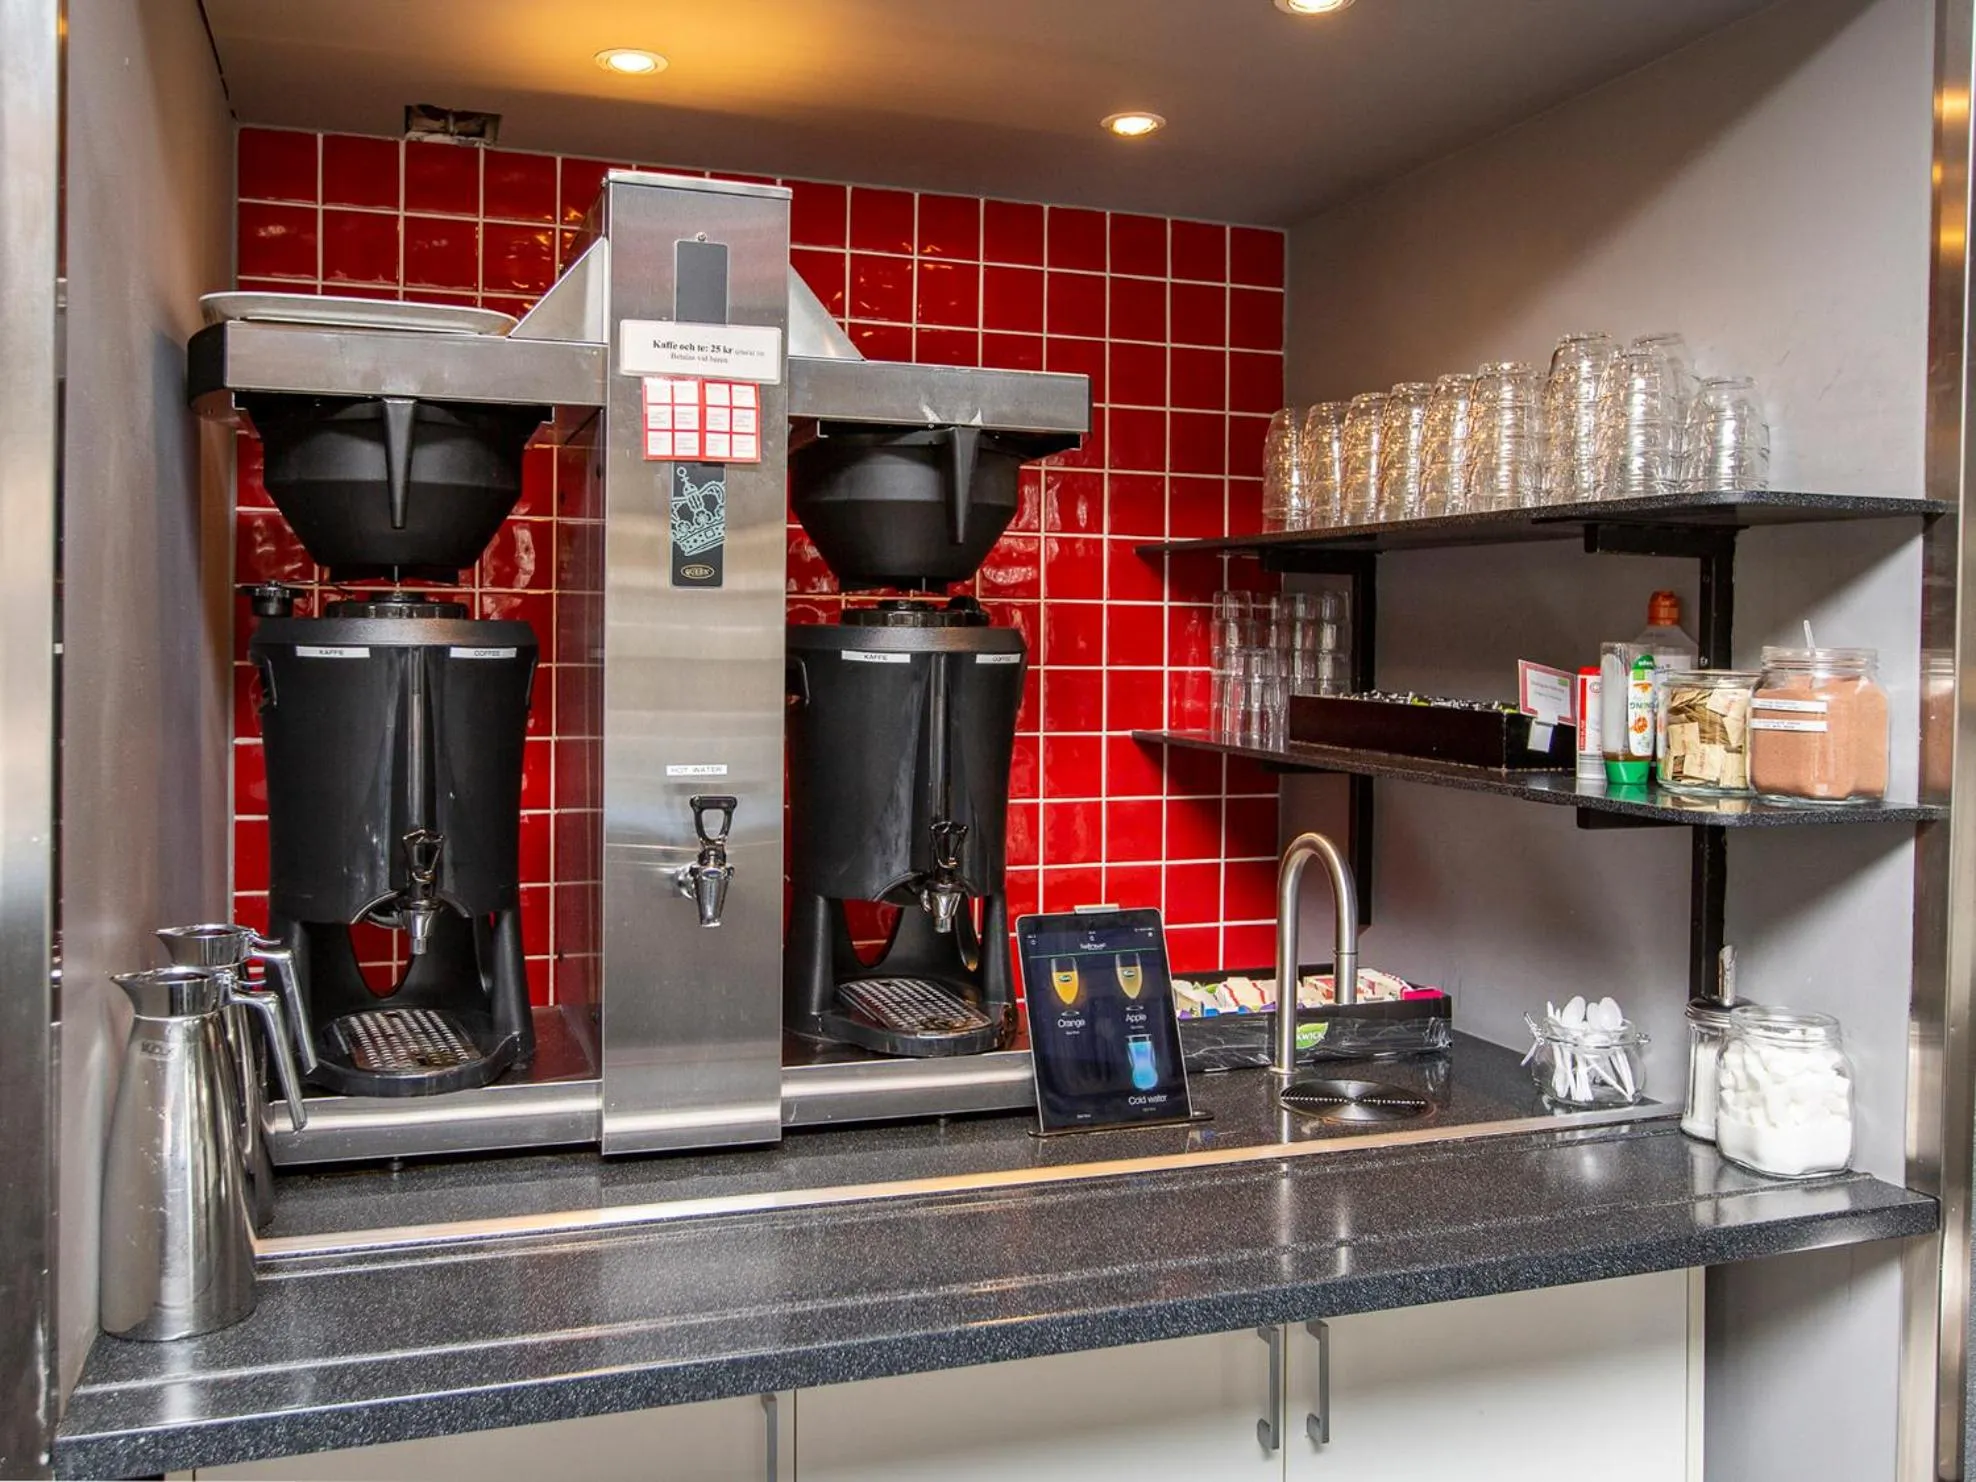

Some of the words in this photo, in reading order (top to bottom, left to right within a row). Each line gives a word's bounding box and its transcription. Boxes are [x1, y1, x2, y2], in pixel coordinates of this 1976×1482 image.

[653, 340, 677, 350] Kaffe
[680, 343, 695, 351] och
[698, 344, 708, 352] te:
[711, 344, 720, 353] 25
[723, 345, 733, 354] kr
[1057, 1018, 1086, 1028] Orange
[1125, 1014, 1147, 1023] Apple
[1128, 1095, 1147, 1105] Cold
[1147, 1095, 1168, 1103] water
